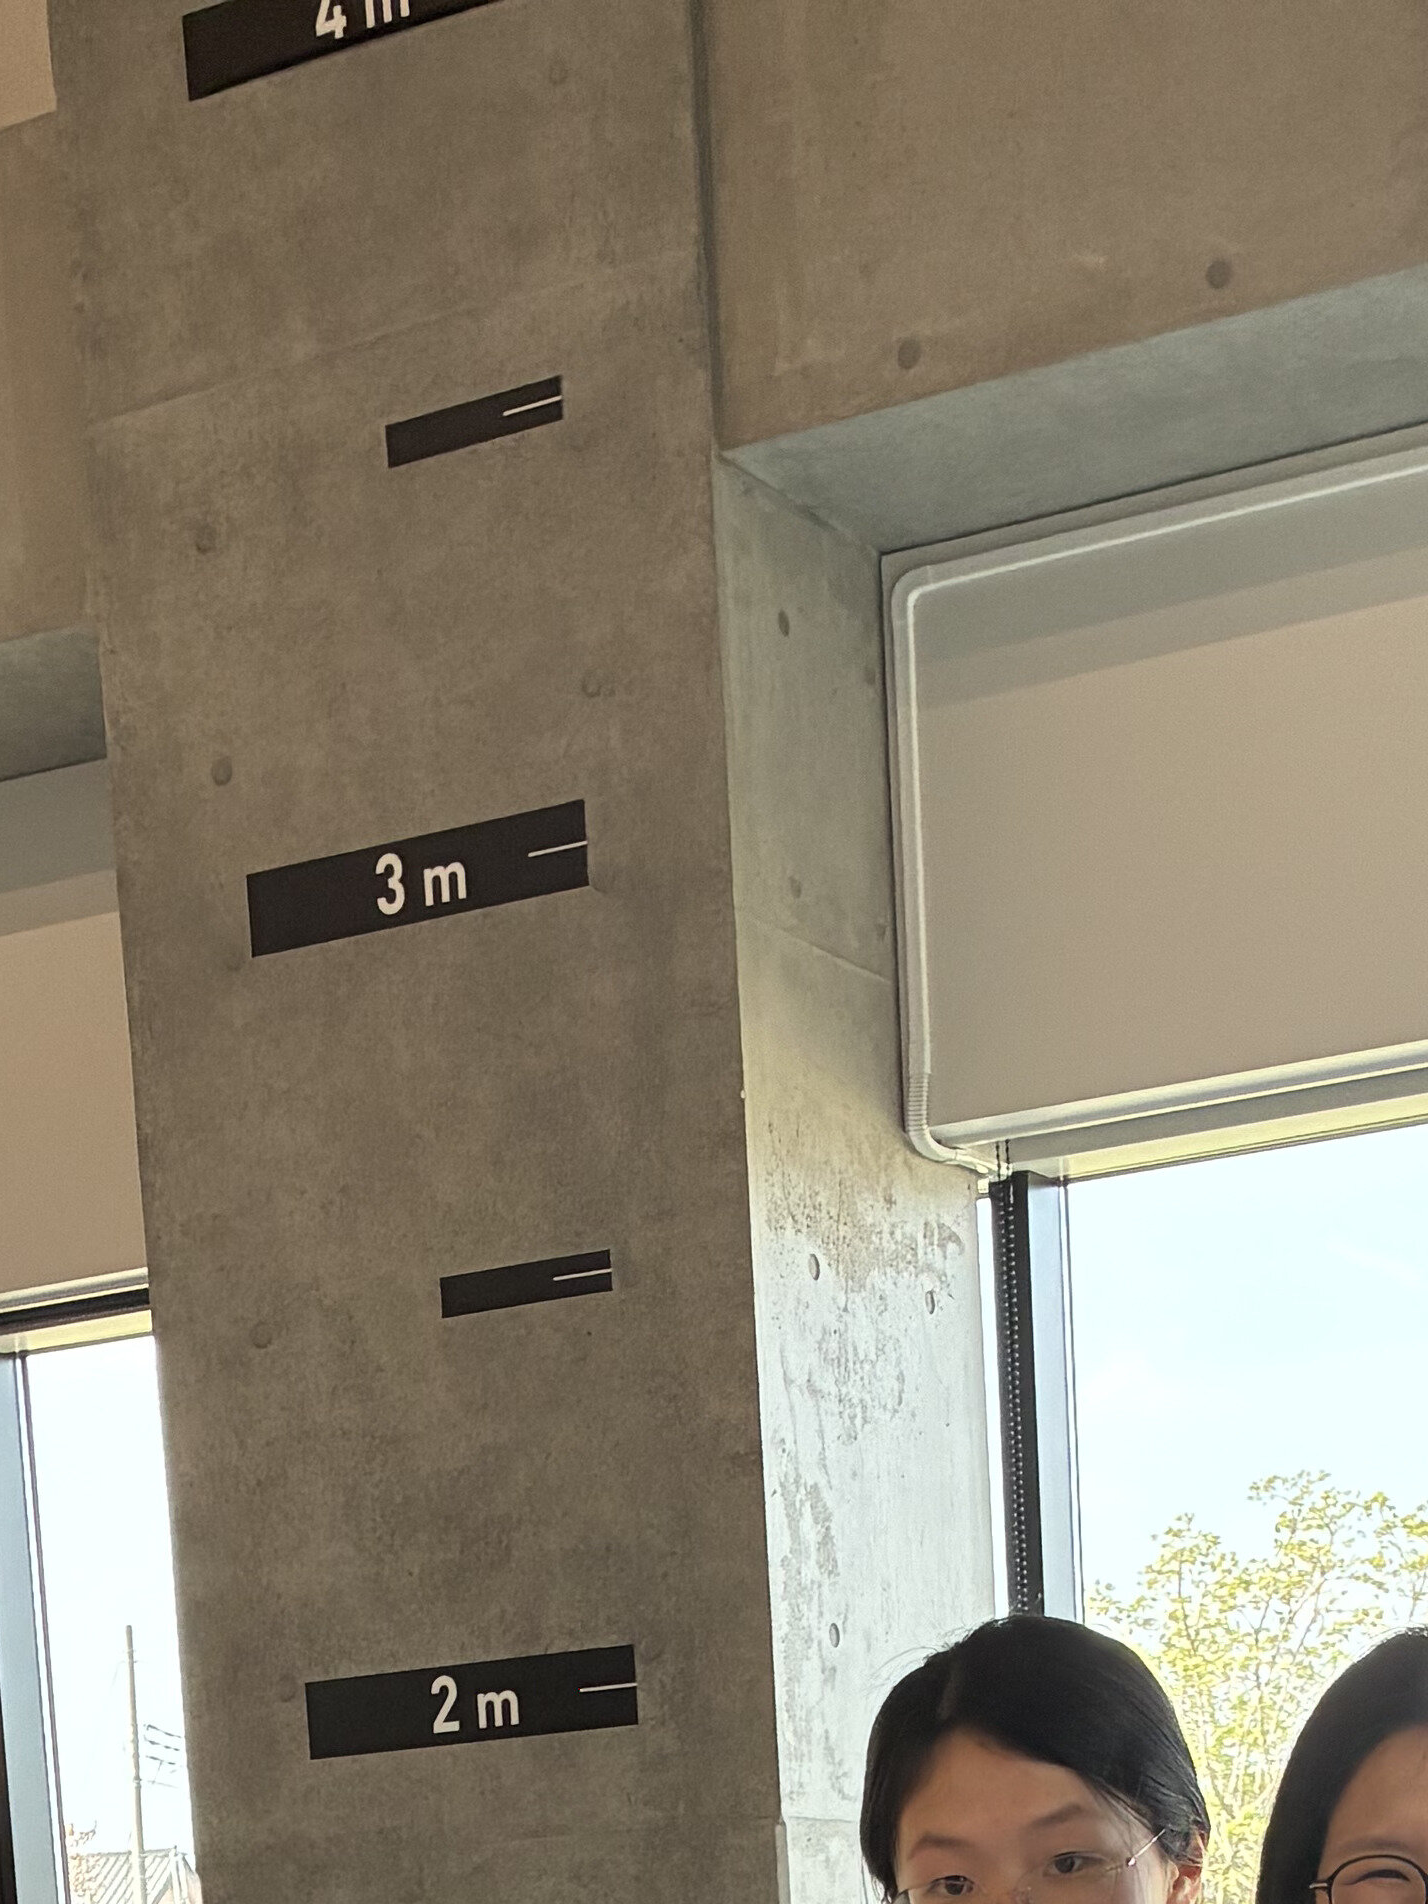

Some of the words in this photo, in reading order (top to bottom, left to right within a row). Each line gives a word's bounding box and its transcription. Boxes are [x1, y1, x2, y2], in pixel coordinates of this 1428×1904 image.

[315, 0, 347, 39] 4
[375, 852, 405, 915] 3
[423, 859, 468, 906] m
[430, 1675, 460, 1734] 2
[477, 1688, 520, 1729] m
